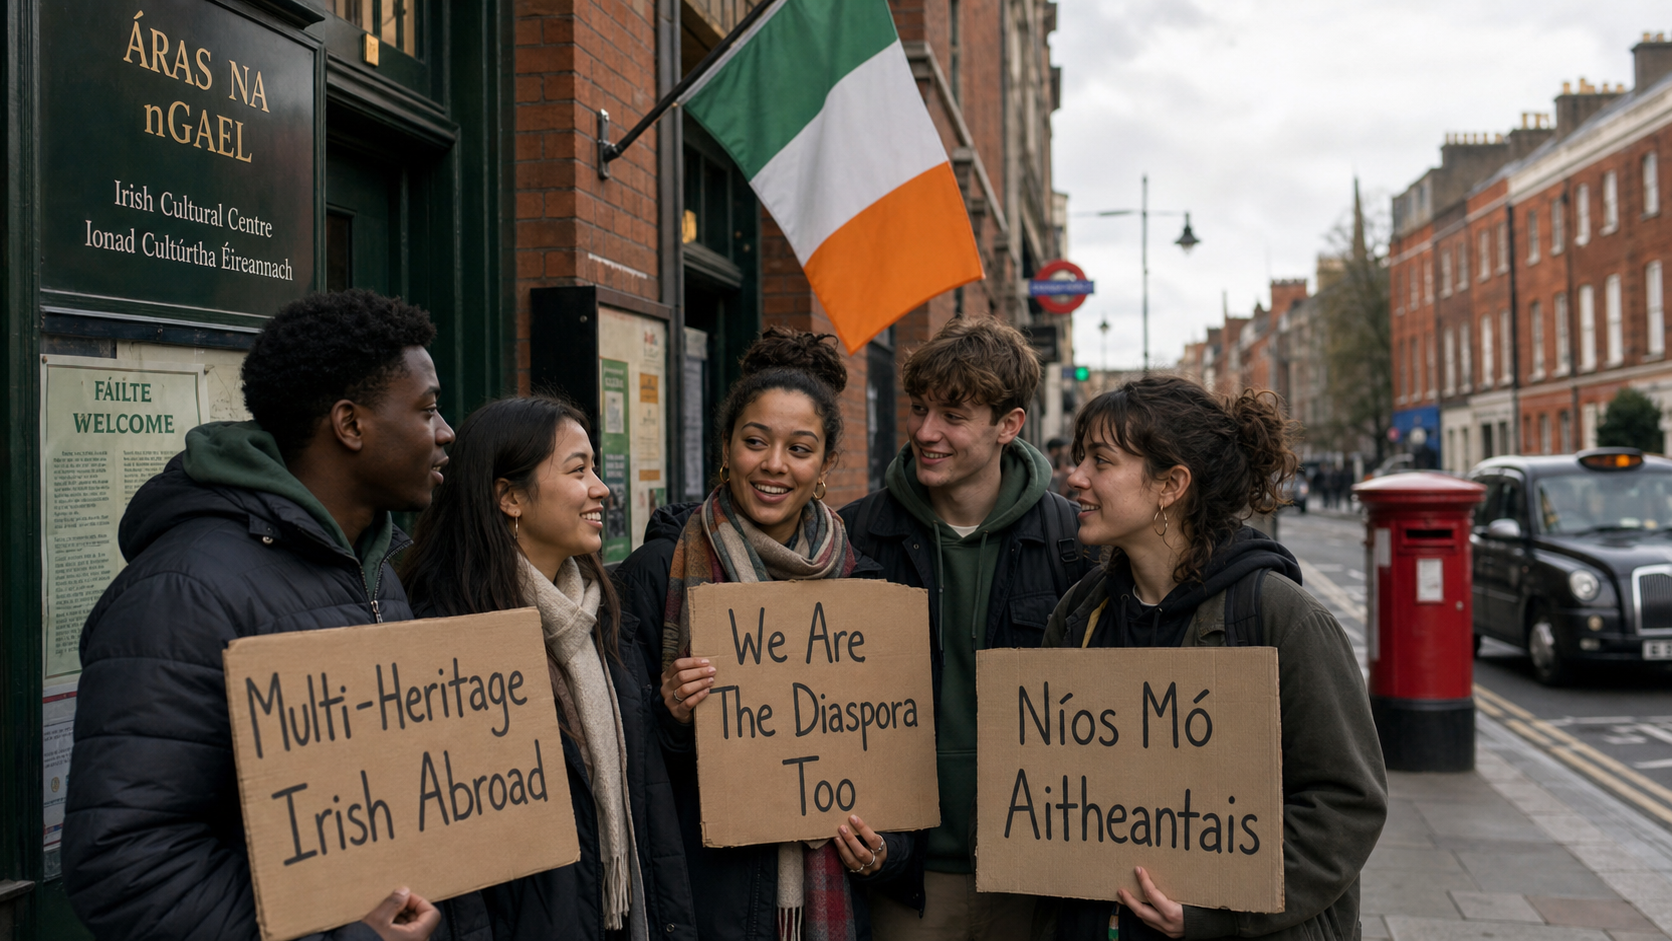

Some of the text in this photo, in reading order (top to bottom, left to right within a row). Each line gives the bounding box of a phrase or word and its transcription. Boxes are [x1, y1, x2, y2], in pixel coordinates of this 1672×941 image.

[123, 10, 270, 113] ÁRAS NA
[143, 101, 252, 163] nGAEL
[114, 179, 273, 238] Irish Cultural Centre
[85, 220, 293, 281] Ionad Cultúrtha Éireannach
[94, 376, 152, 403] FÁILTE
[73, 412, 175, 434] WELCOME
[728, 601, 866, 666] We Are
[245, 657, 528, 759] Multi-Heritage
[709, 682, 918, 751] The Diaspora
[1019, 681, 1212, 749] Níos Mó
[271, 739, 549, 866] Irish Abroad
[782, 755, 856, 816] Too
[1004, 768, 1260, 855] Aitheantais
